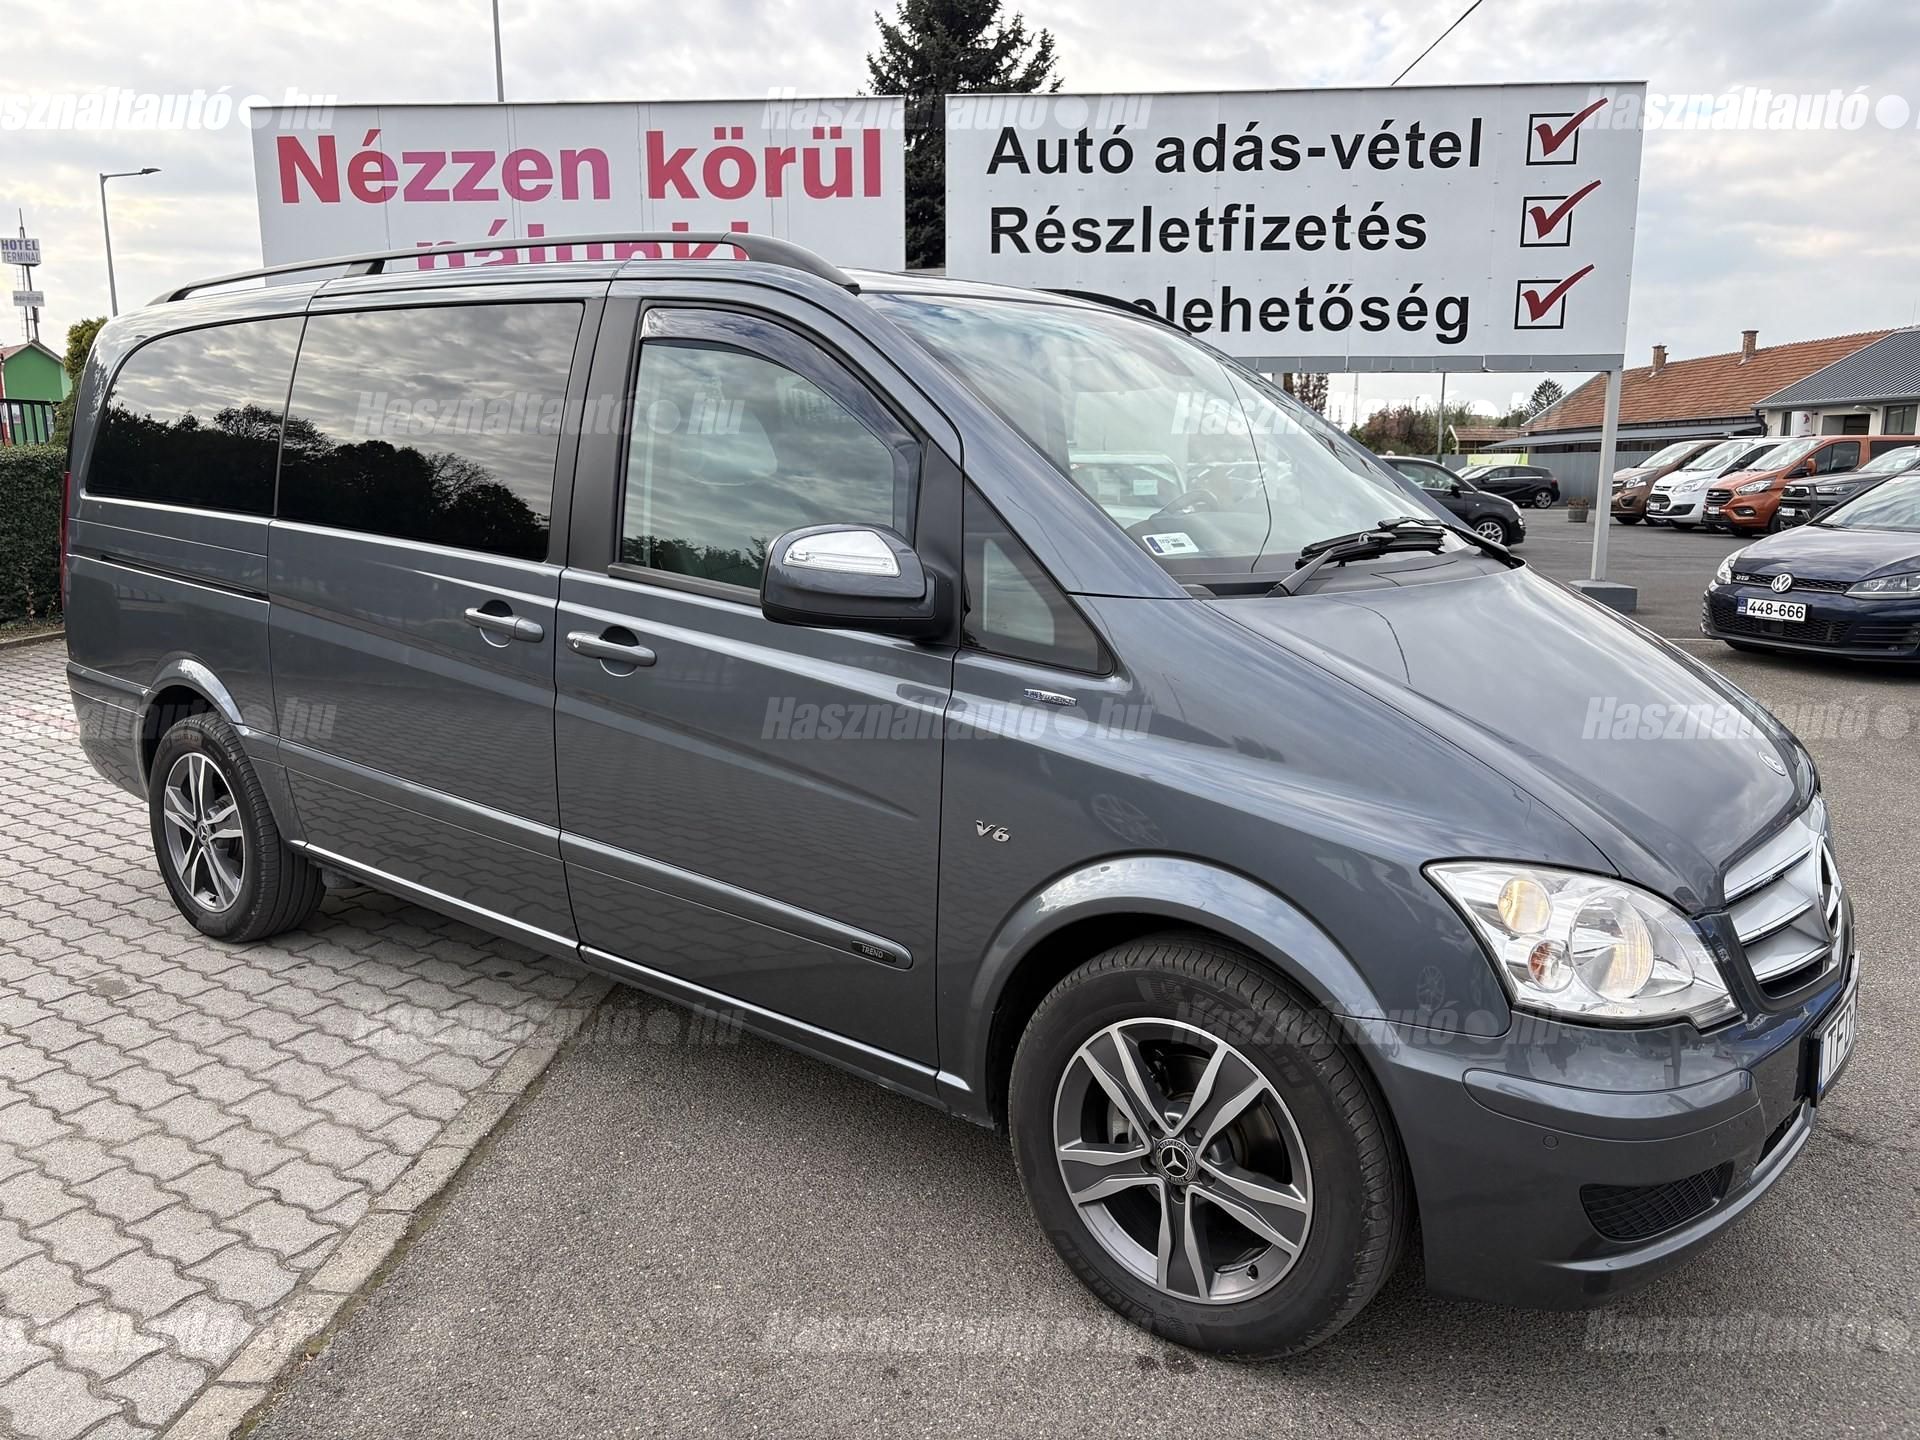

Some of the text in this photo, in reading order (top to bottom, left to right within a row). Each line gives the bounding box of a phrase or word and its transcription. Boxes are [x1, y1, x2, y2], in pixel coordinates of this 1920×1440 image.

[987, 118, 1481, 174] Autó adás-vétel
[278, 128, 880, 203] Nézzen körül
[992, 202, 1426, 253] Részletfizetés
[1, 240, 39, 251] HOTEL
[2, 252, 40, 263] TERMINAL
[1749, 601, 1804, 619] 448-666
[976, 820, 1012, 842] V6
[861, 945, 884, 959] TREND
